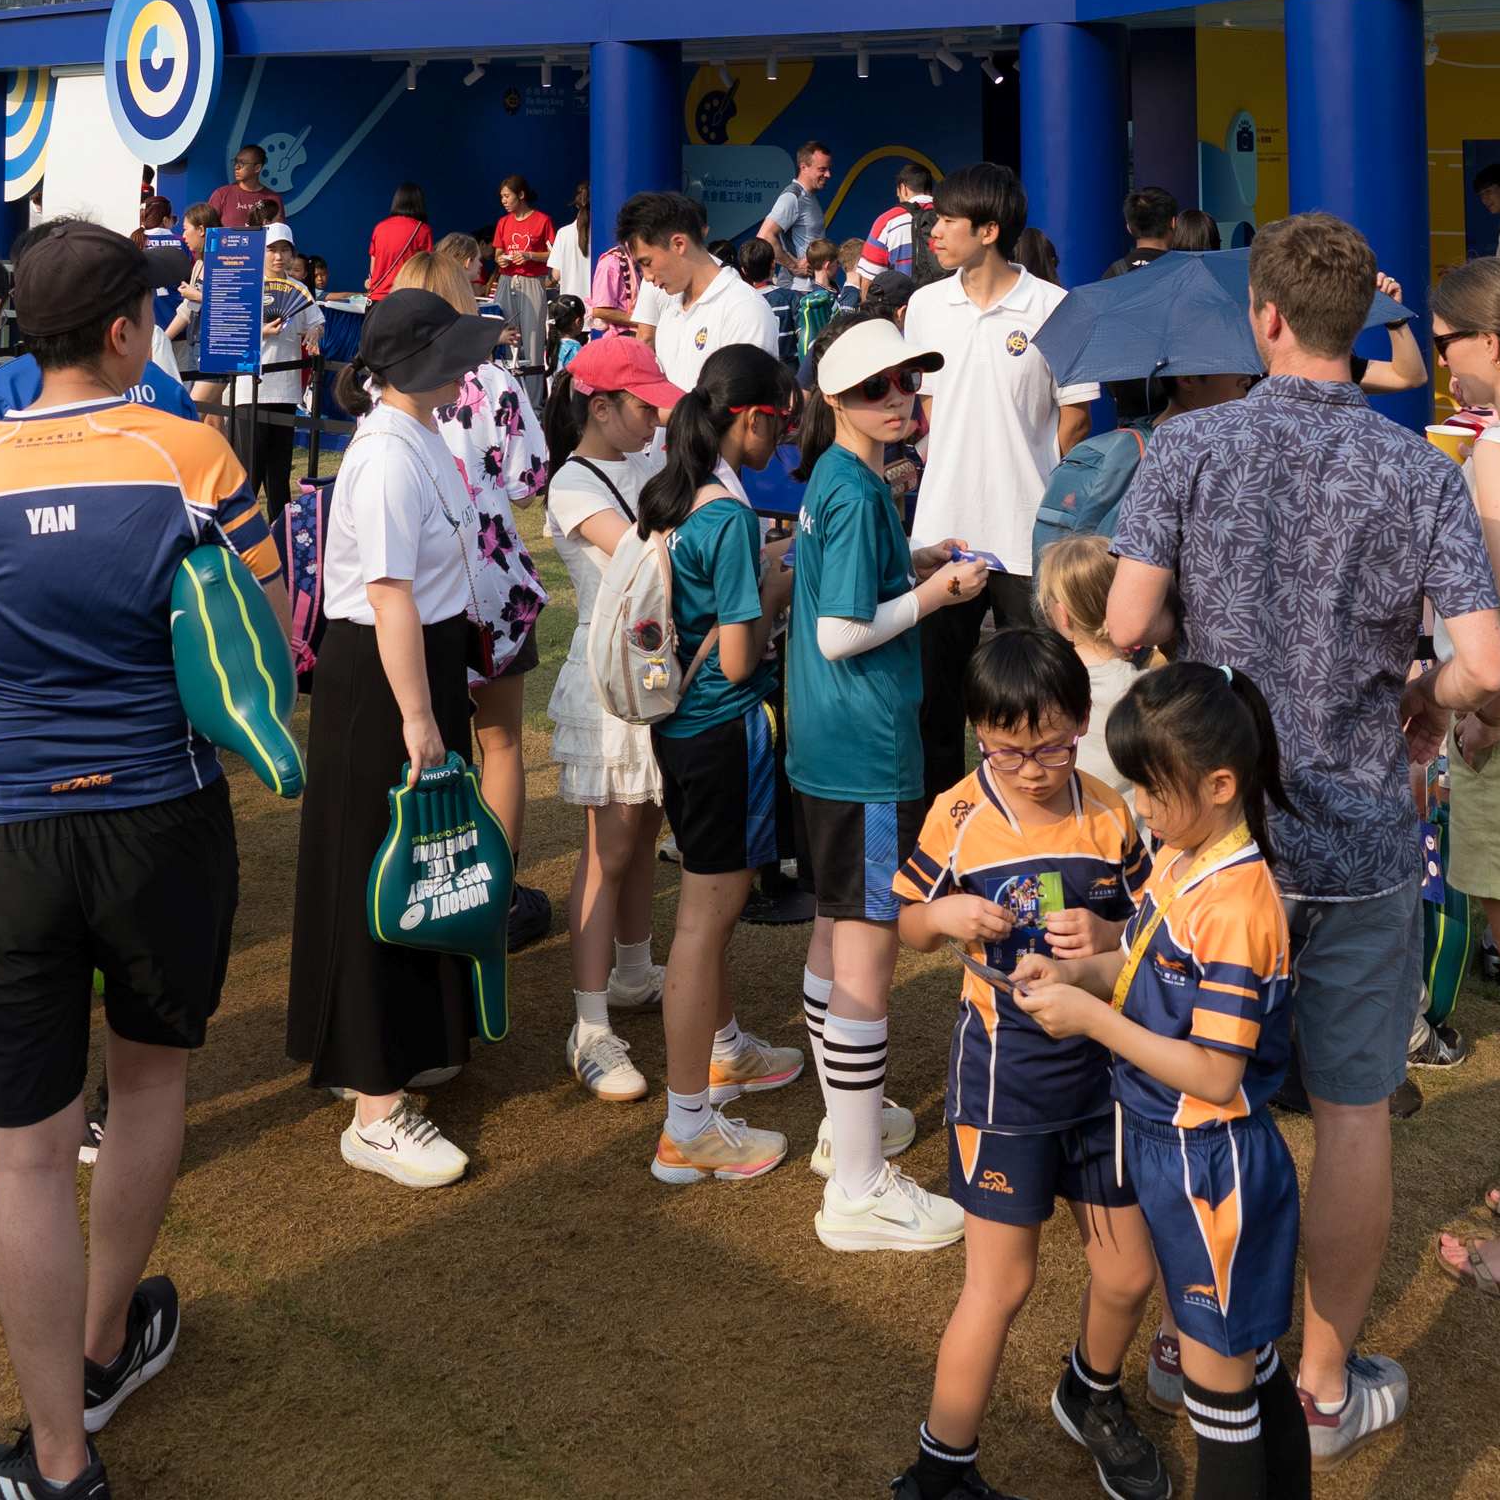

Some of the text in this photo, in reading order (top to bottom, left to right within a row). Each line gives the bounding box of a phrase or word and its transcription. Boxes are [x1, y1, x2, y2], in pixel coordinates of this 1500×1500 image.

[745, 179, 780, 189] Painters
[25, 504, 76, 535] YAN
[419, 770, 450, 781] CATHAY
[412, 829, 478, 864] HONG KONG
[427, 856, 456, 878] LIKE
[407, 862, 493, 905] DOES RUGBY
[431, 882, 490, 921] NOBODY
